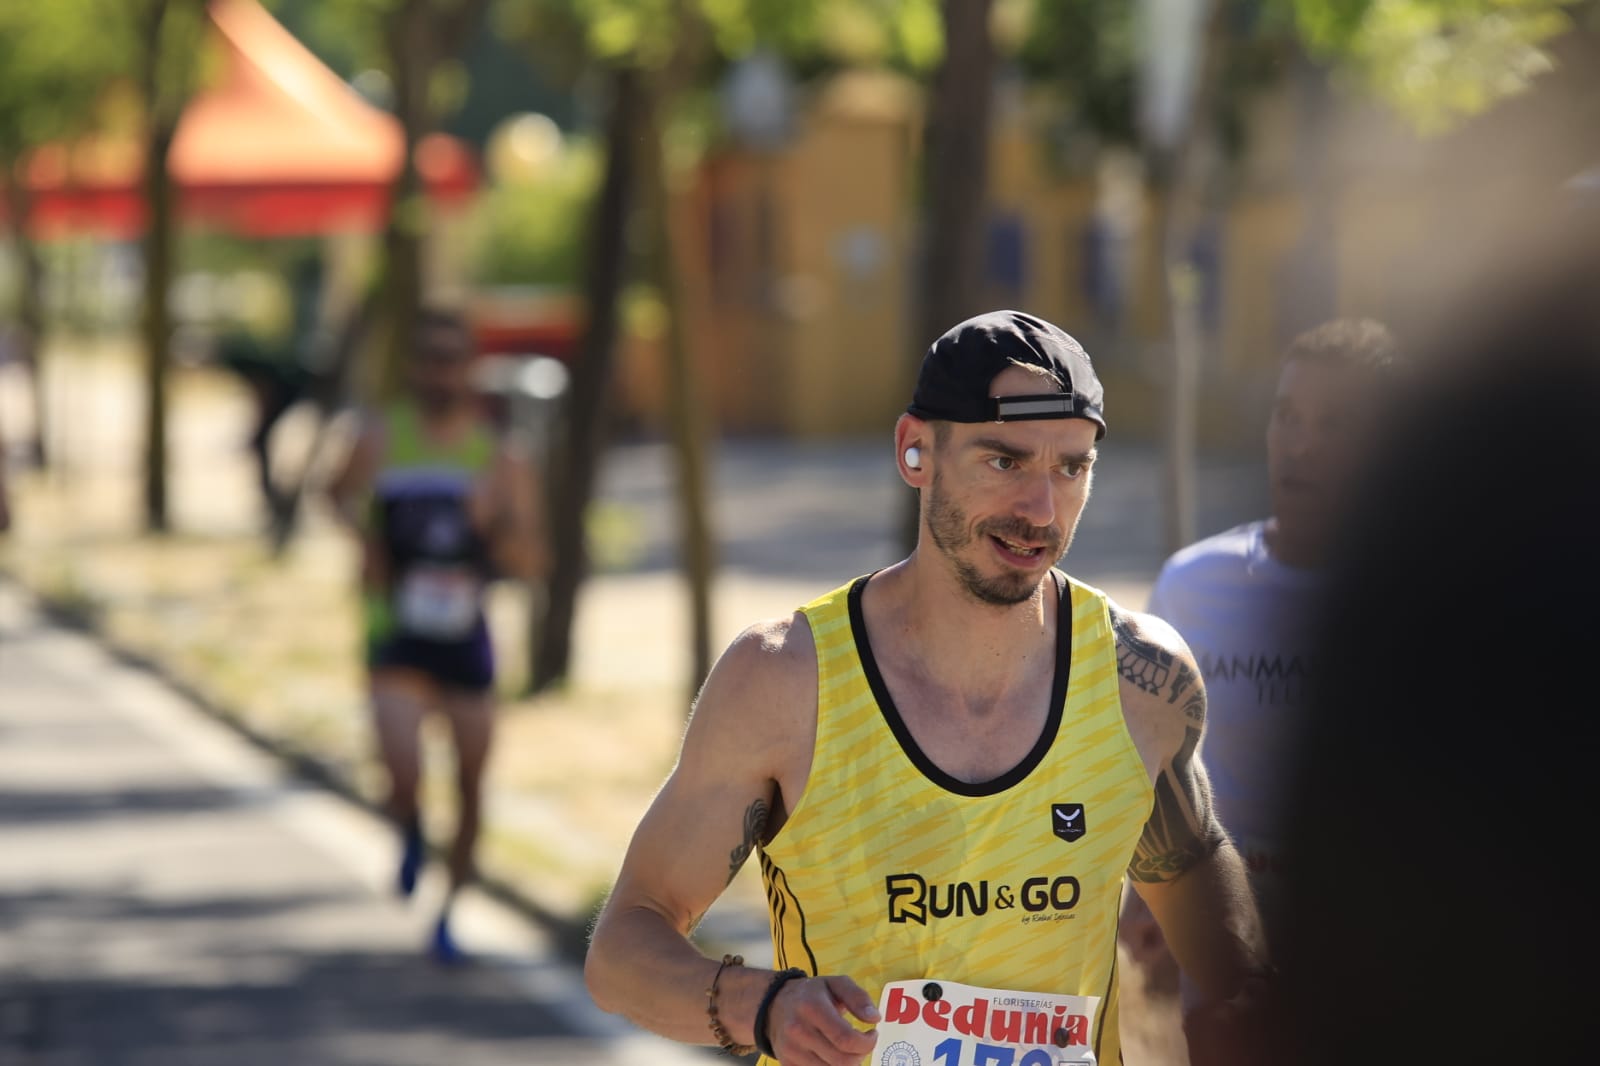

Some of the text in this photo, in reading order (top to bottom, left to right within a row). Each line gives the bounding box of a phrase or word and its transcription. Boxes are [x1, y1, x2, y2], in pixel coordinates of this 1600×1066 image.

[885, 873, 1081, 926] RUN & GO
